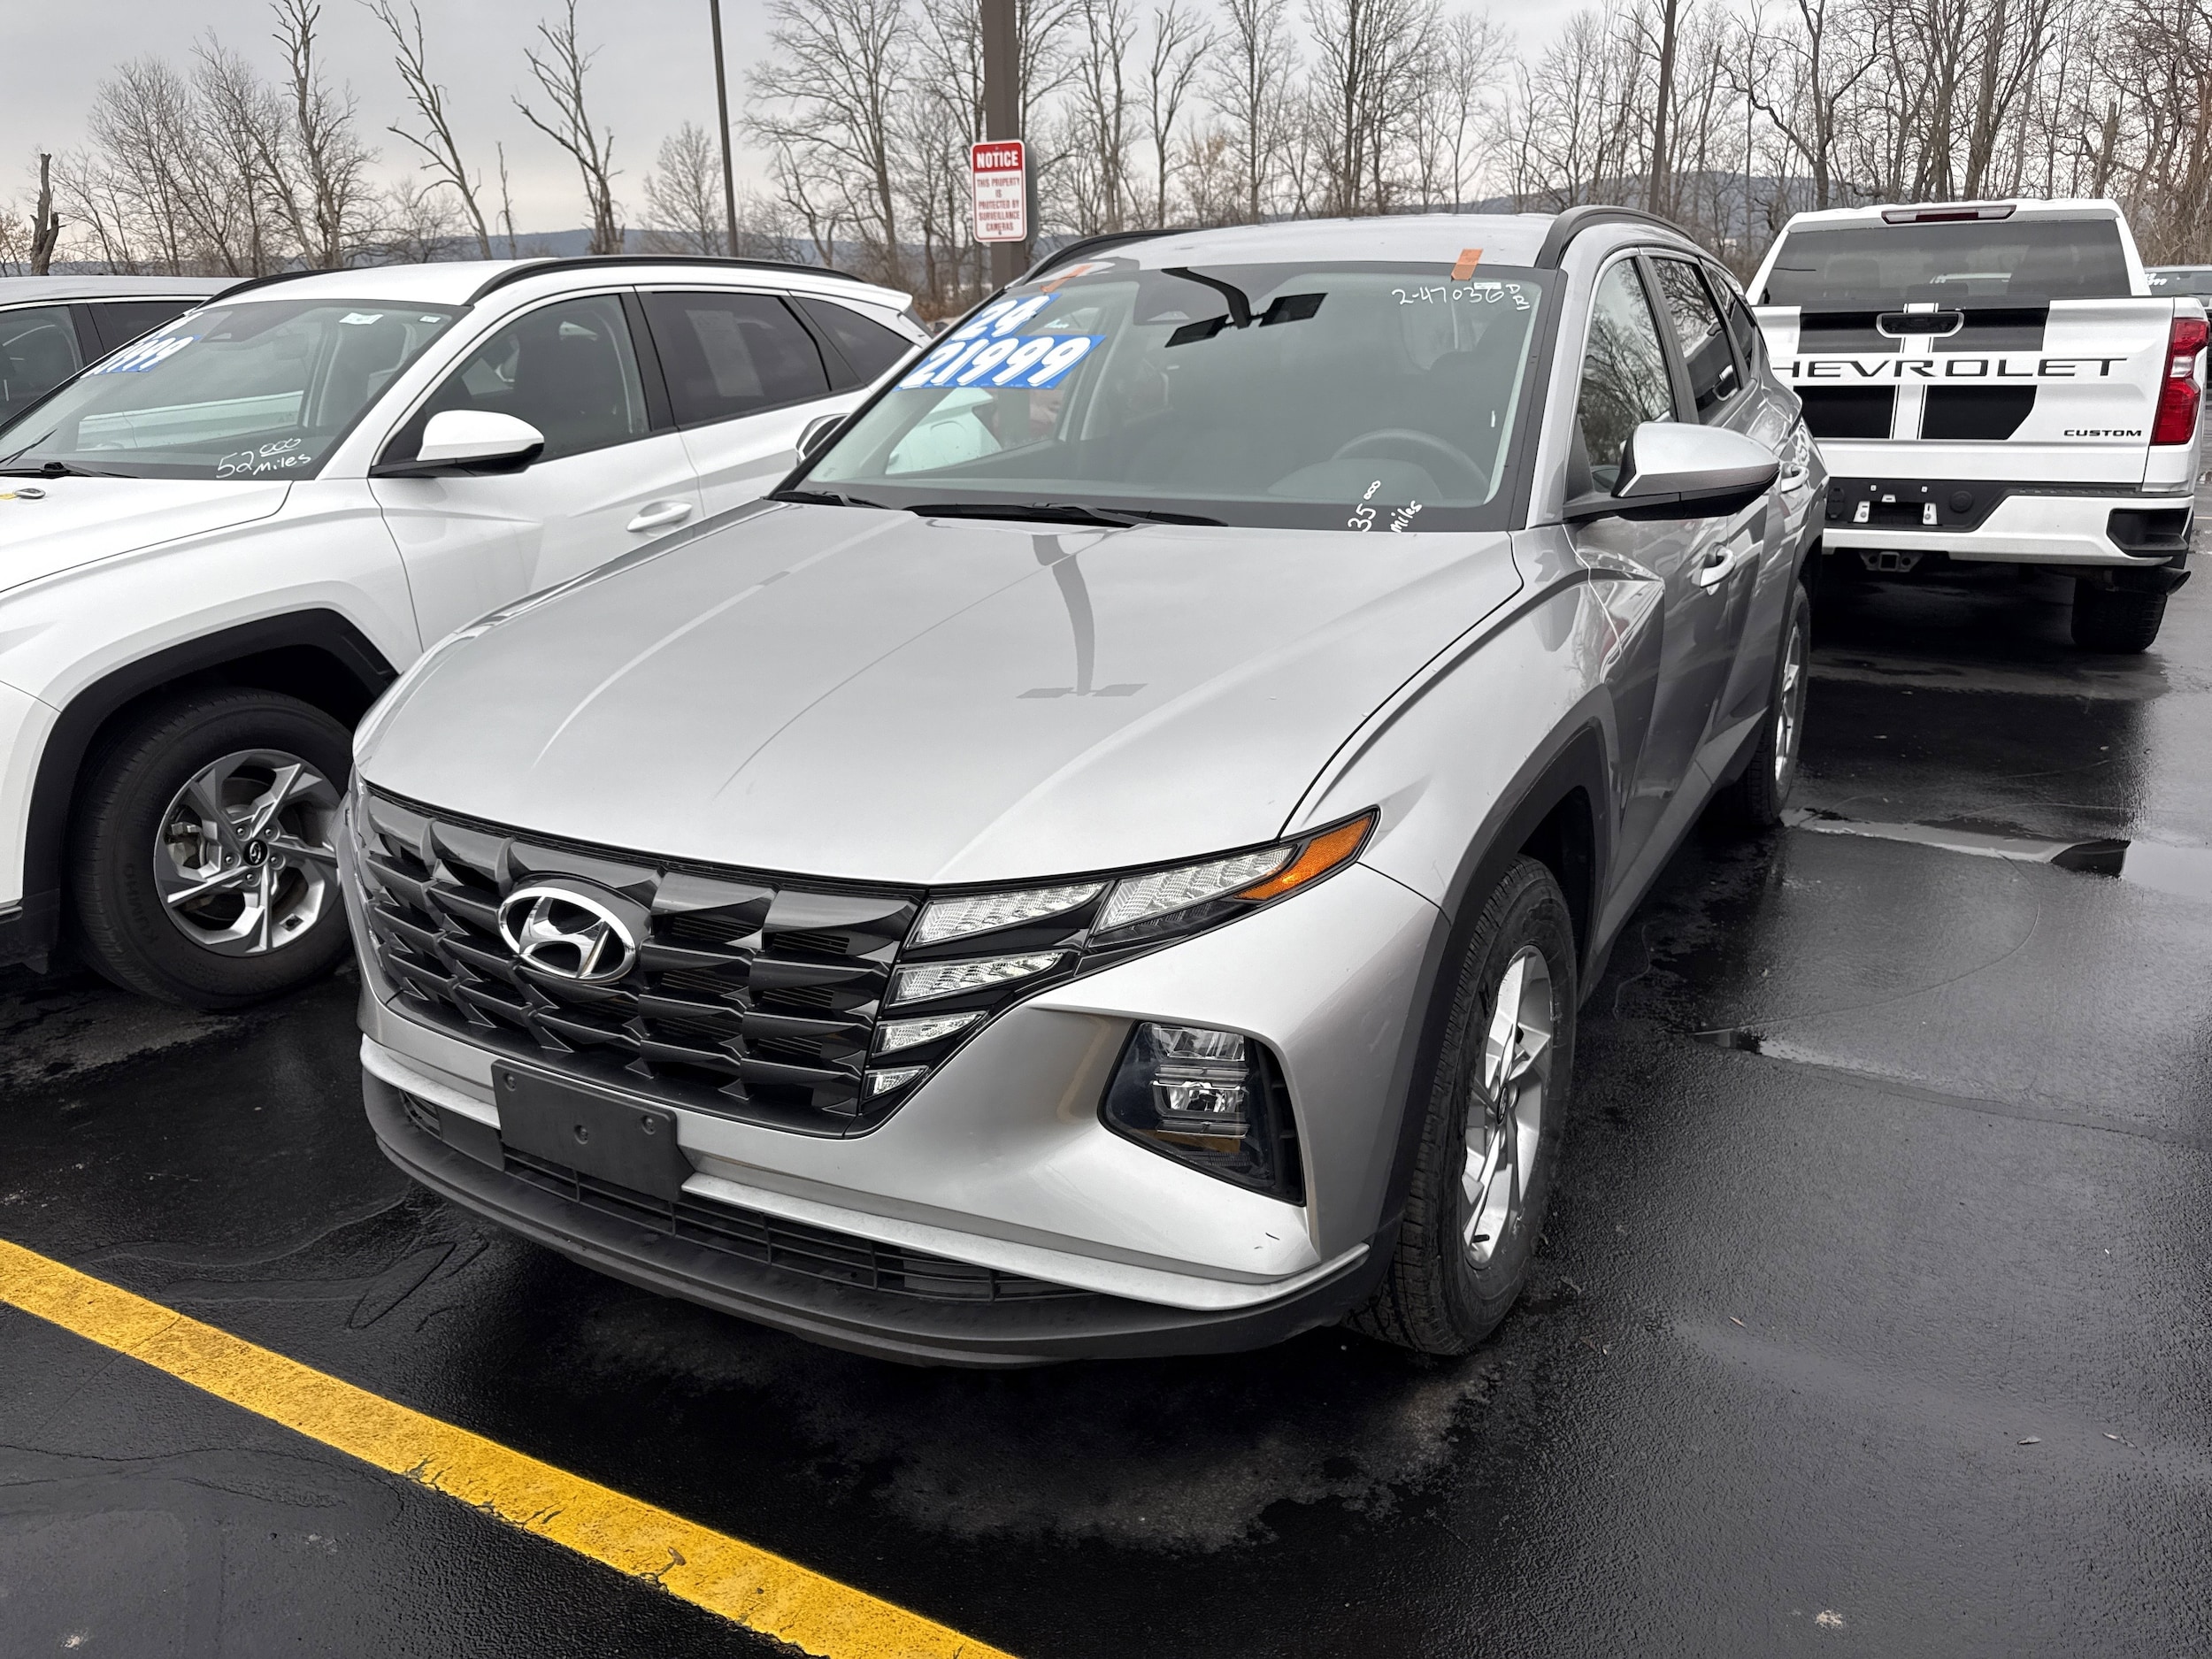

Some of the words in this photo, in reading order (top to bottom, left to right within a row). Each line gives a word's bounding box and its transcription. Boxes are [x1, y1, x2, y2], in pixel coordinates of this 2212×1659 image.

[976, 150, 1018, 168] NOTICE
[977, 179, 990, 188] THIS
[992, 177, 1019, 188] PROPERTY
[995, 189, 1002, 198] IS
[979, 200, 1010, 210] PROTECTED
[1012, 200, 1019, 209] BY
[979, 211, 1020, 221] SURVEILLANCE
[986, 222, 1013, 232] CAMERAS
[951, 296, 1050, 342] 24
[899, 336, 1091, 388] 21999
[1772, 357, 2127, 378] HEVROLET
[122, 862, 160, 944] KUMHO
